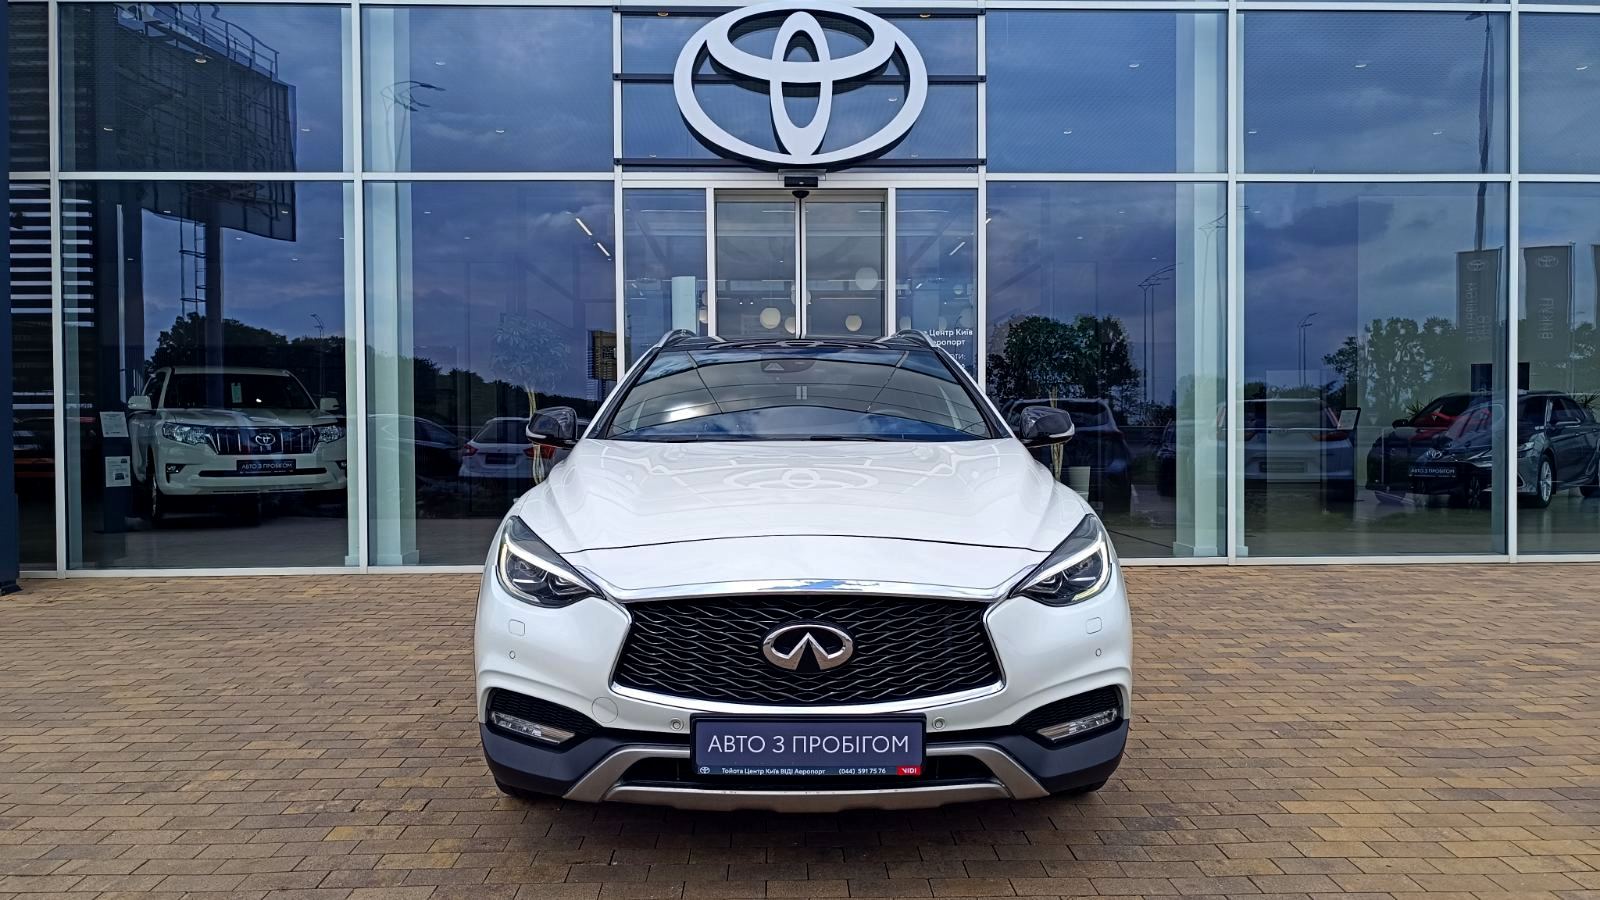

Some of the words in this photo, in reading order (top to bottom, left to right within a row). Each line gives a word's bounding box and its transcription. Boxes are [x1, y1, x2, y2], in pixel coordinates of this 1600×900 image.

[929, 329, 954, 337] Центр
[955, 328, 973, 336] Київ
[707, 735, 766, 753] АВТО
[772, 735, 785, 753] З
[792, 735, 909, 753] ПРОБІГОМ
[744, 768, 764, 776] Центр
[794, 768, 826, 776] Аеропорт
